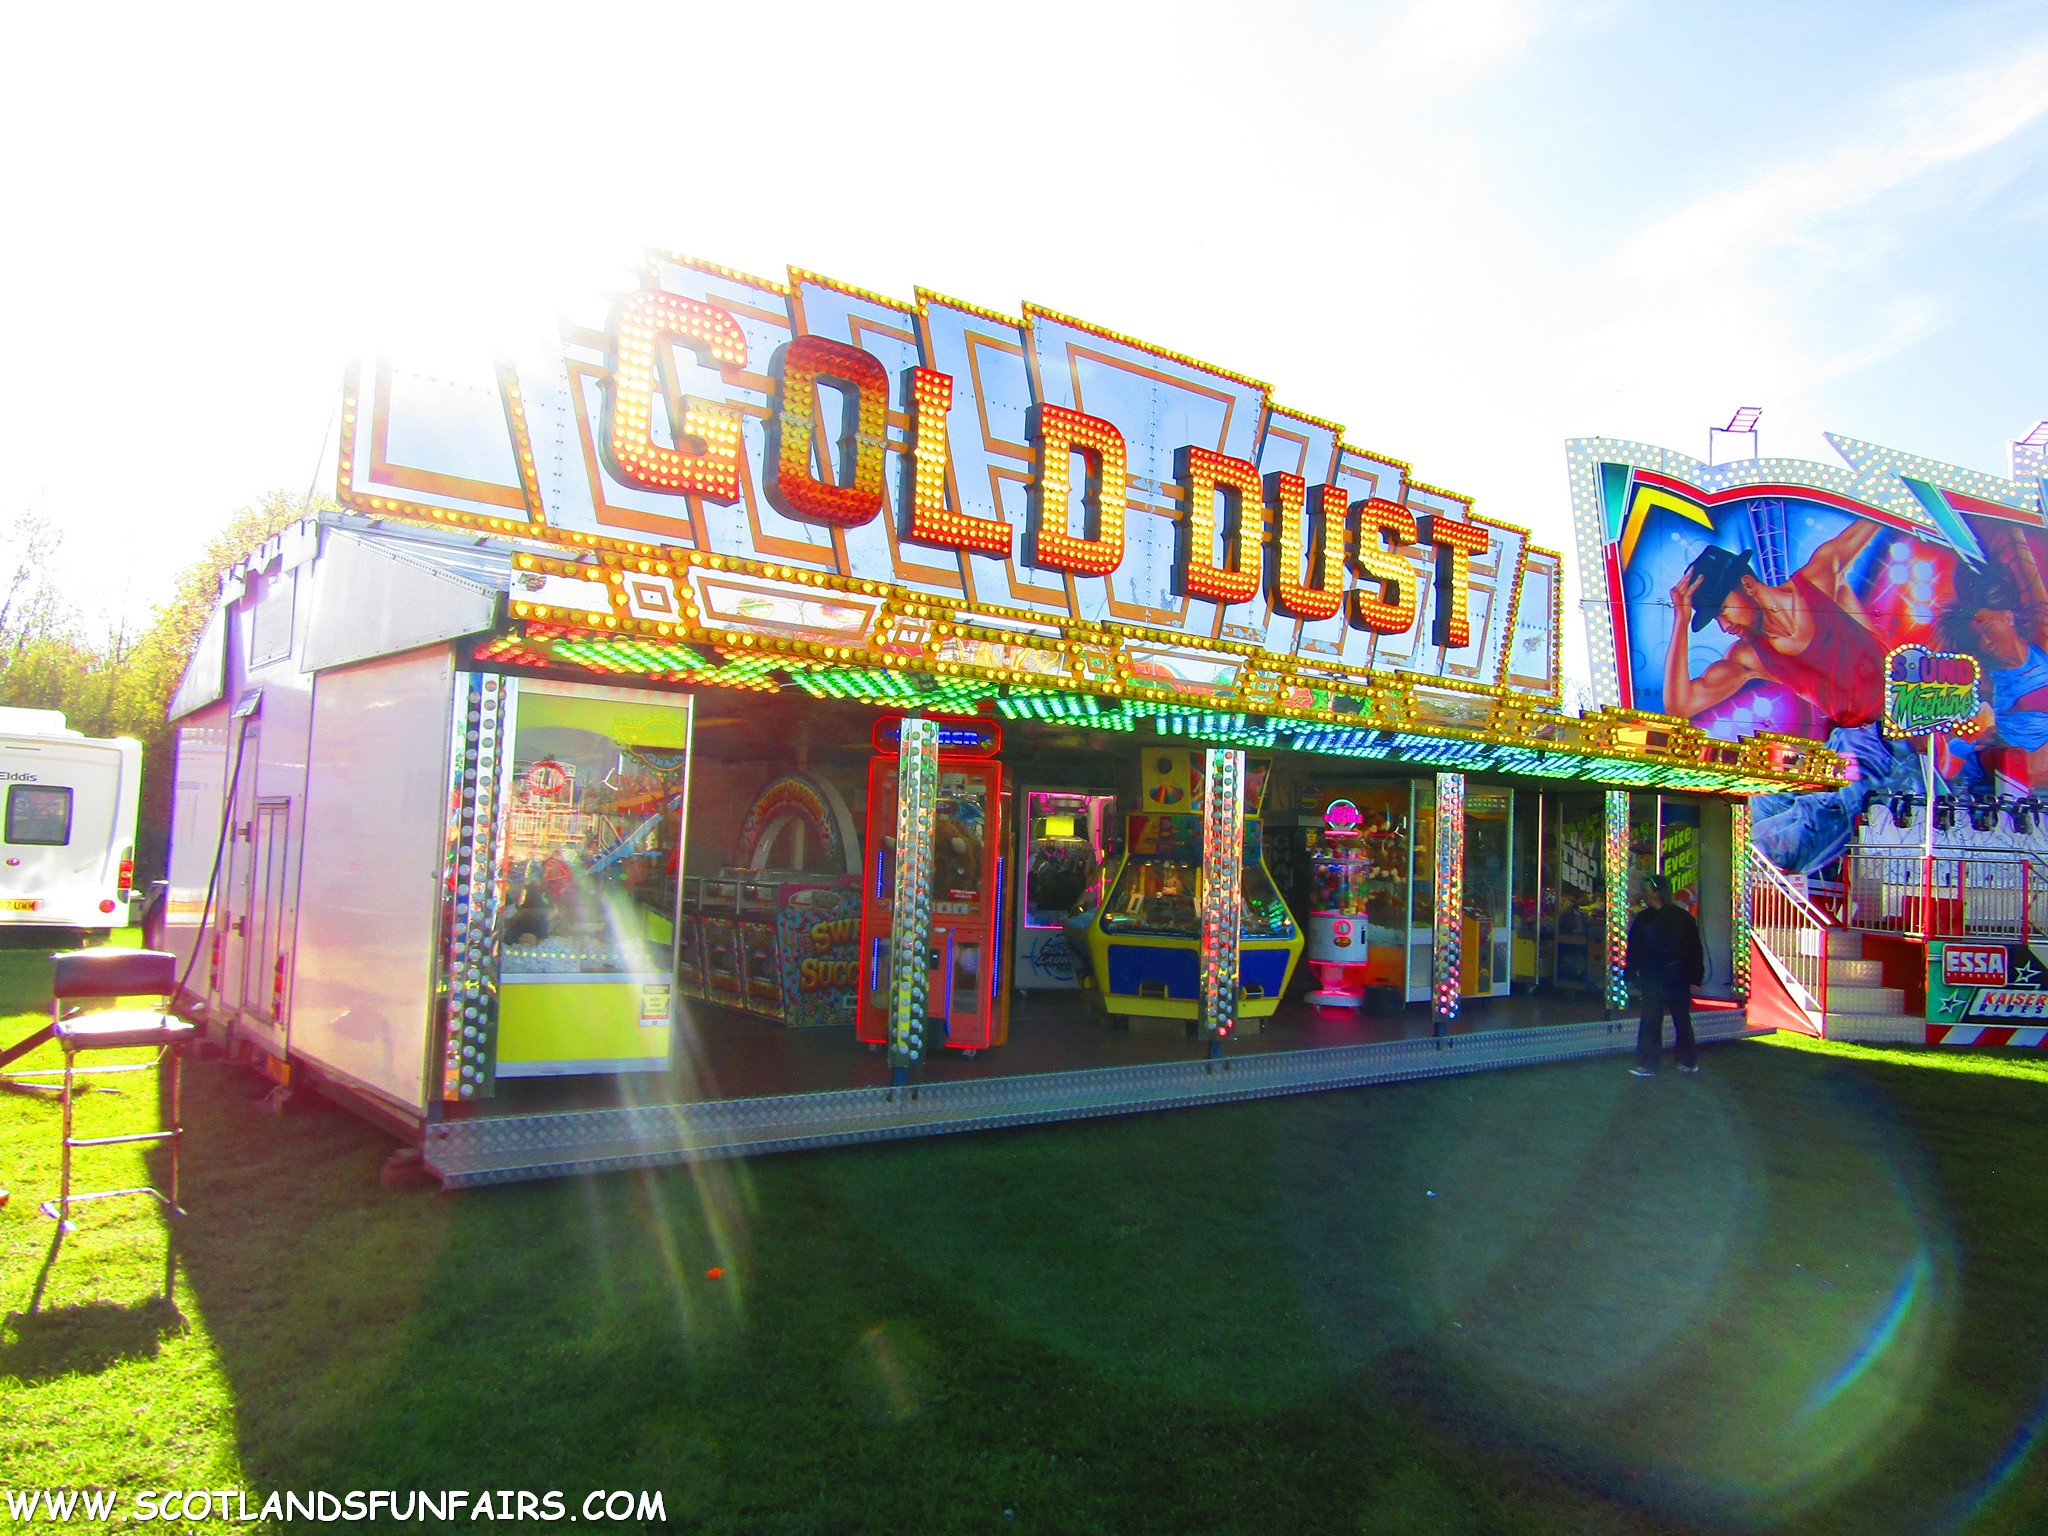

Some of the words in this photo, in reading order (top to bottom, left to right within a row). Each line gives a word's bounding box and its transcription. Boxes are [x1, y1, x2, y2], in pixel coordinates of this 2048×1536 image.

[598, 288, 1128, 578] GOLD
[1171, 445, 1489, 648] DUST
[1890, 649, 1975, 685] SOUND
[1891, 684, 1972, 729] Machine
[0, 772, 38, 782] Elddis
[1946, 951, 2004, 973] ESSA
[1979, 1004, 2044, 1014] RIDES
[1983, 992, 2048, 1006] KAISER
